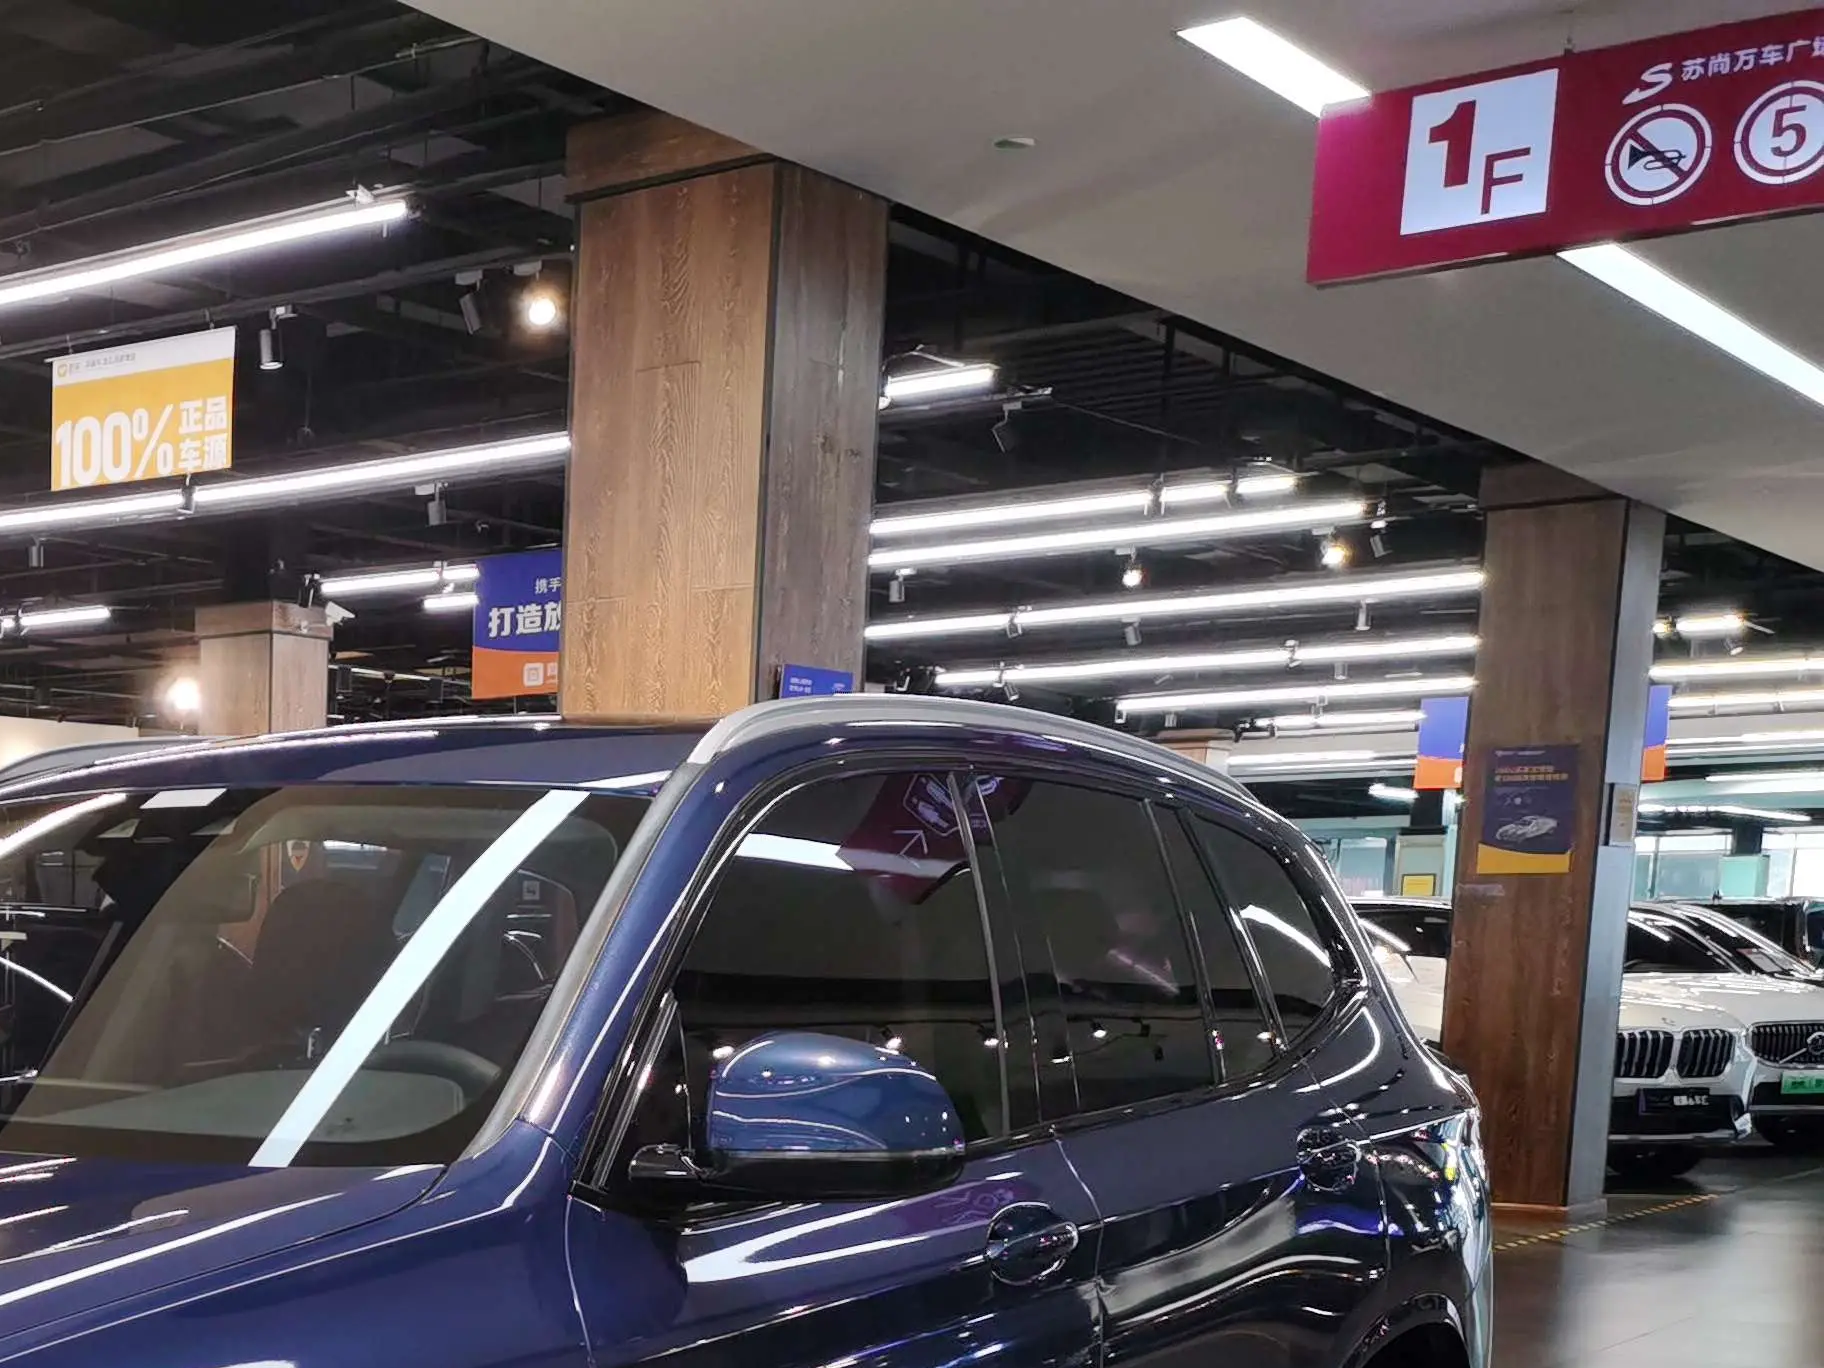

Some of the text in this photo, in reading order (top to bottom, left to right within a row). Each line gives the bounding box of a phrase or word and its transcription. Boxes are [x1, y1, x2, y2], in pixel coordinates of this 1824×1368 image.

[1770, 104, 1807, 158] 5
[179, 396, 227, 434] 正品
[55, 404, 173, 488] 100%
[179, 433, 227, 468] 车源
